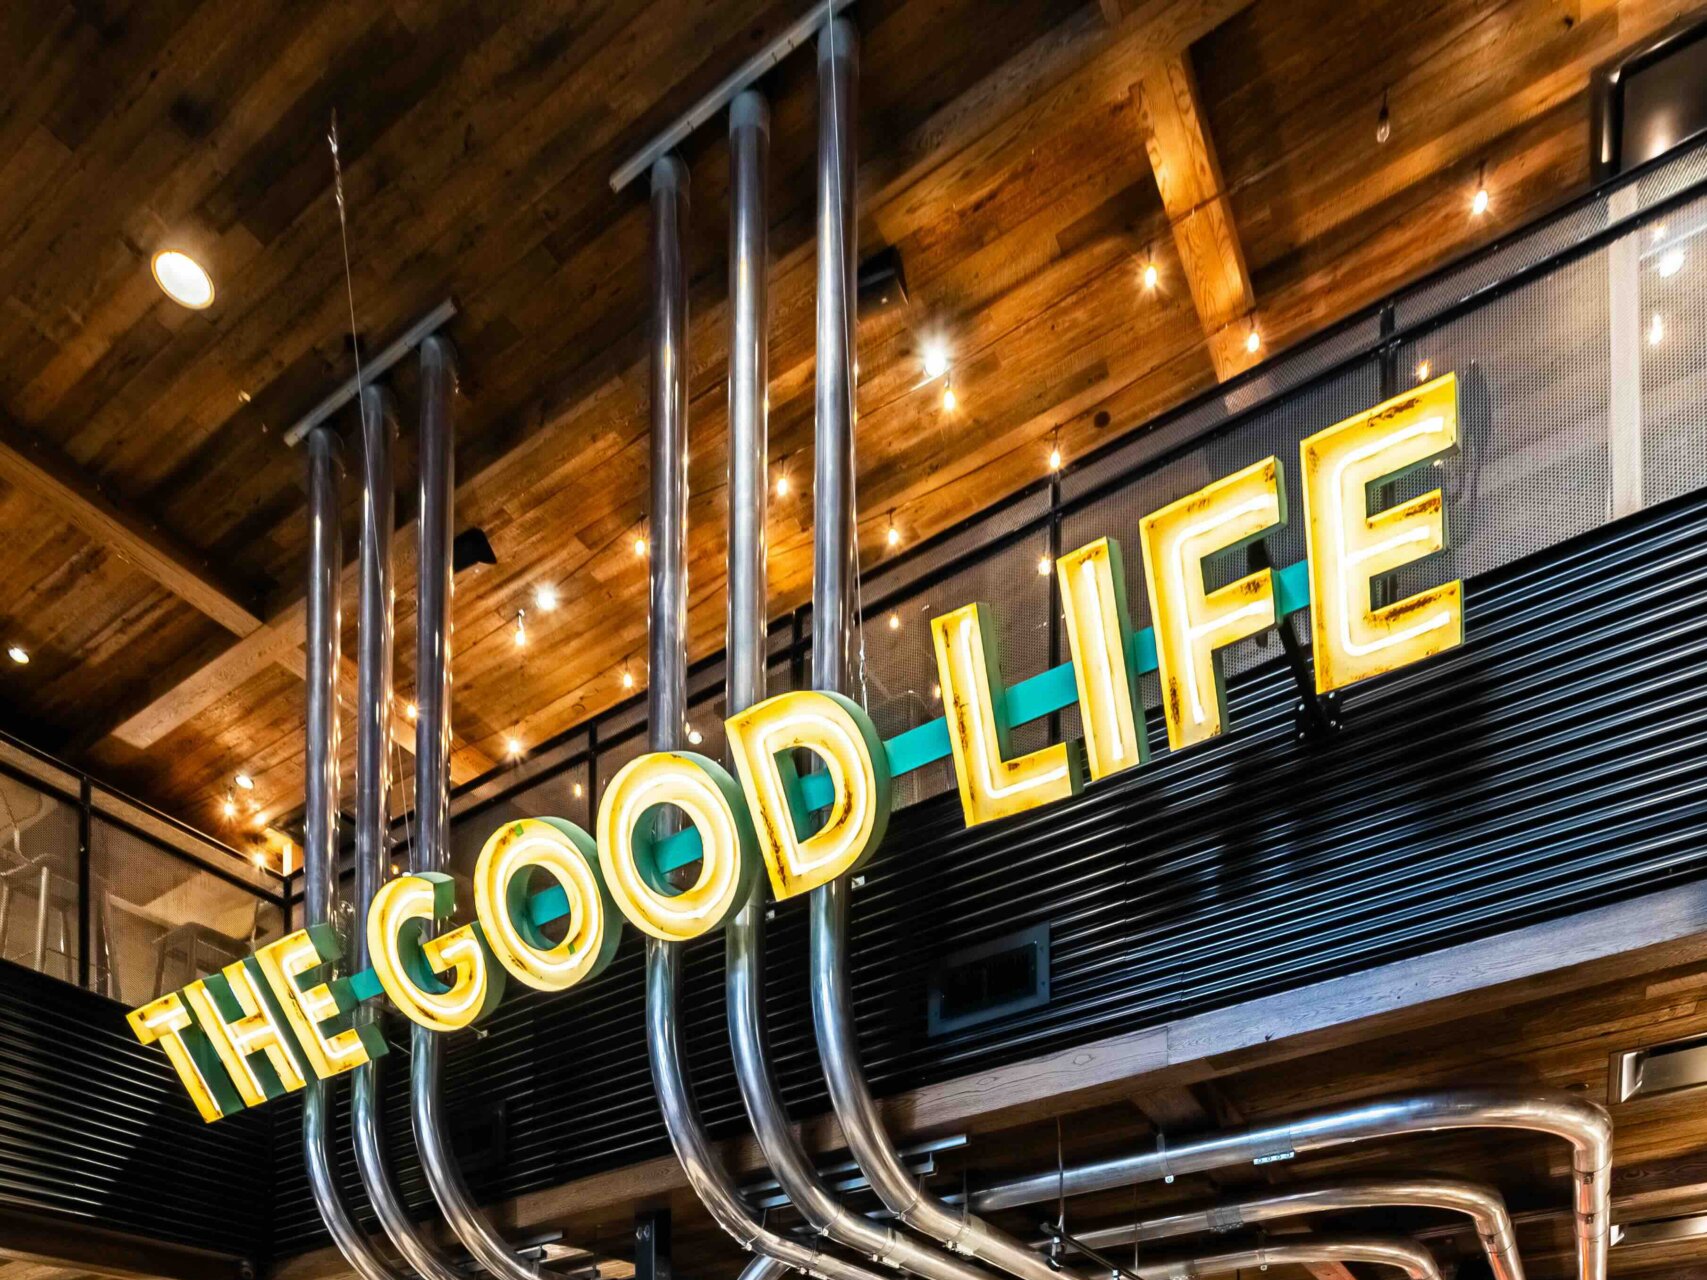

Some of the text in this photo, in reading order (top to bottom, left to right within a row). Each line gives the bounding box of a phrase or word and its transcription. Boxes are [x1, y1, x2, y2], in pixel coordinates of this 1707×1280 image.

[126, 371, 1464, 1123] THE GOOD LIFE
